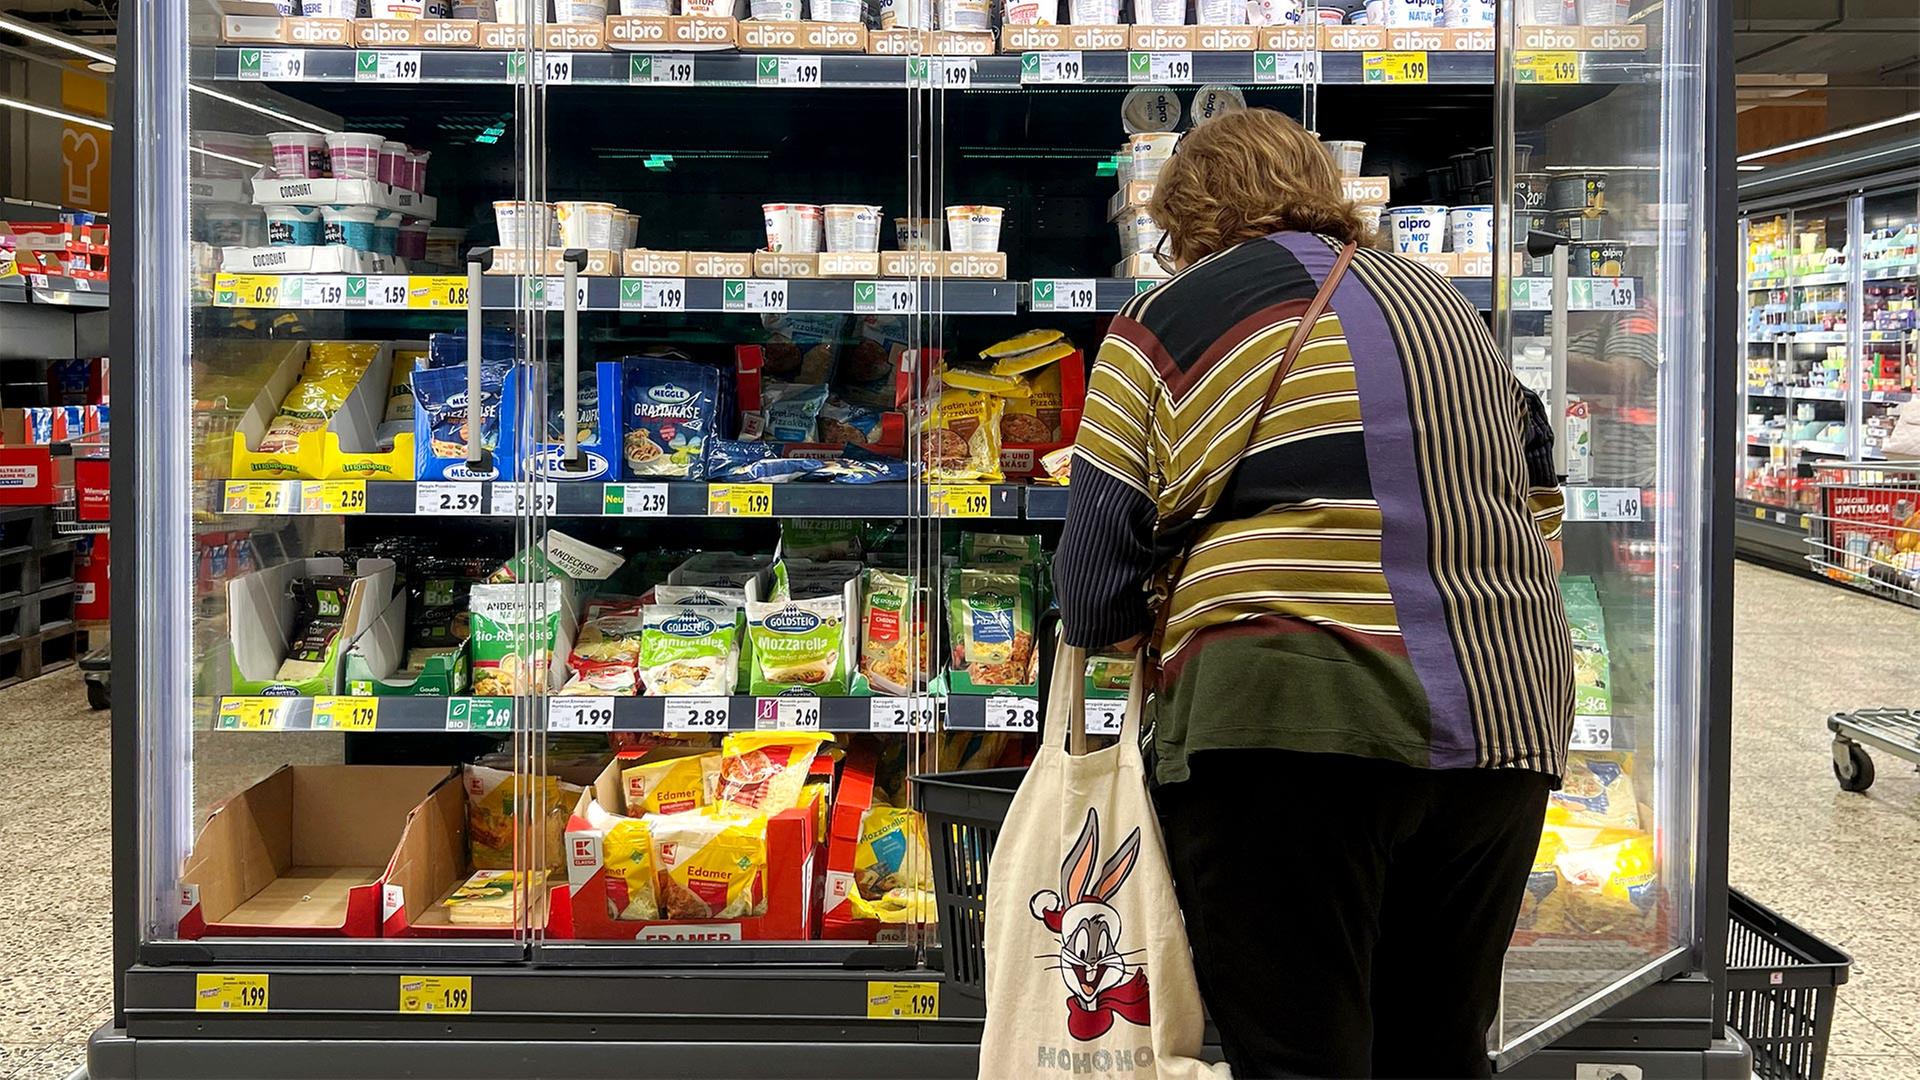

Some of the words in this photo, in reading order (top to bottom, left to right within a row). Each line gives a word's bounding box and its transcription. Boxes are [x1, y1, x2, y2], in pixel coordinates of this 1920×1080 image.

[293, 23, 341, 44] alpro
[361, 24, 409, 45] alpro
[424, 24, 472, 46] alpro
[549, 28, 597, 51] alpro
[612, 20, 663, 42] alpro
[677, 20, 727, 42] alpro
[746, 25, 795, 47] alpro
[808, 25, 857, 48] alpro
[1010, 29, 1059, 51] alpro
[1074, 29, 1123, 51] alpro
[1137, 29, 1187, 50] alpro
[1202, 29, 1251, 51] alpro
[1330, 29, 1379, 51] alpro
[1526, 29, 1575, 51] alpro
[1591, 29, 1640, 51] alpro
[1393, 31, 1441, 51] alpro
[395, 61, 417, 78] 1.99
[546, 62, 568, 80] 1.99
[669, 64, 691, 81] 1.99
[796, 65, 818, 83] 1.99
[945, 67, 967, 84] 1.99
[1056, 62, 1079, 79] 1.99
[1168, 62, 1189, 79] 1.99
[1403, 62, 1424, 80] 1.99
[1554, 63, 1575, 80] 1.99
[1156, 95, 1169, 123] alpro
[1202, 92, 1216, 119] alpro
[280, 183, 312, 199] COCOGURT
[972, 214, 990, 224] alpro
[1398, 216, 1431, 232] alpro
[1411, 233, 1430, 242] NOT
[253, 251, 286, 268] COCOGURT
[1601, 248, 1623, 258] alpro
[631, 256, 681, 278] alpro
[695, 257, 745, 278] alpro
[761, 258, 809, 278] alpro
[824, 255, 872, 276] alpro
[950, 256, 998, 278] alpro
[255, 285, 279, 303] 0.99
[320, 287, 342, 304] 1.59
[384, 286, 406, 304] 1.59
[659, 290, 682, 307] 1.99
[763, 290, 785, 308] 1.99
[1070, 290, 1093, 308] 1.99
[1610, 289, 1632, 306] 1.39
[634, 402, 701, 420] GRATINKÄSE
[536, 459, 597, 472] MEGE
[341, 491, 363, 508] 2.59
[439, 494, 479, 511] 2.39
[643, 494, 665, 512] 2.39
[748, 495, 769, 512] 1.99
[966, 496, 988, 513] 1.99
[1616, 499, 1638, 516] 1.49
[1835, 504, 1889, 515] UMTAUSCH
[550, 546, 602, 576] ANDECHSER
[557, 560, 582, 579] NATUR
[319, 600, 340, 614] Bio
[667, 622, 710, 633] GOLDSTEIG
[770, 618, 815, 629] GOLDSTEIG
[758, 636, 829, 652] Mozzarella
[353, 708, 374, 726] 1.79
[448, 720, 464, 728] BIO
[486, 708, 510, 727] 2.69
[575, 709, 612, 726] 1.99
[688, 710, 727, 726] 2.89
[795, 708, 818, 726] 2.69
[894, 710, 933, 726] 2.89
[657, 789, 696, 802] Edamer
[859, 815, 906, 845] Mozzarella
[687, 865, 733, 881] Edamer
[241, 986, 265, 1007] 1.99
[444, 988, 468, 1009] 1.99
[911, 994, 936, 1015] 1.99
[1038, 1045, 1155, 1075] HOHOHO
